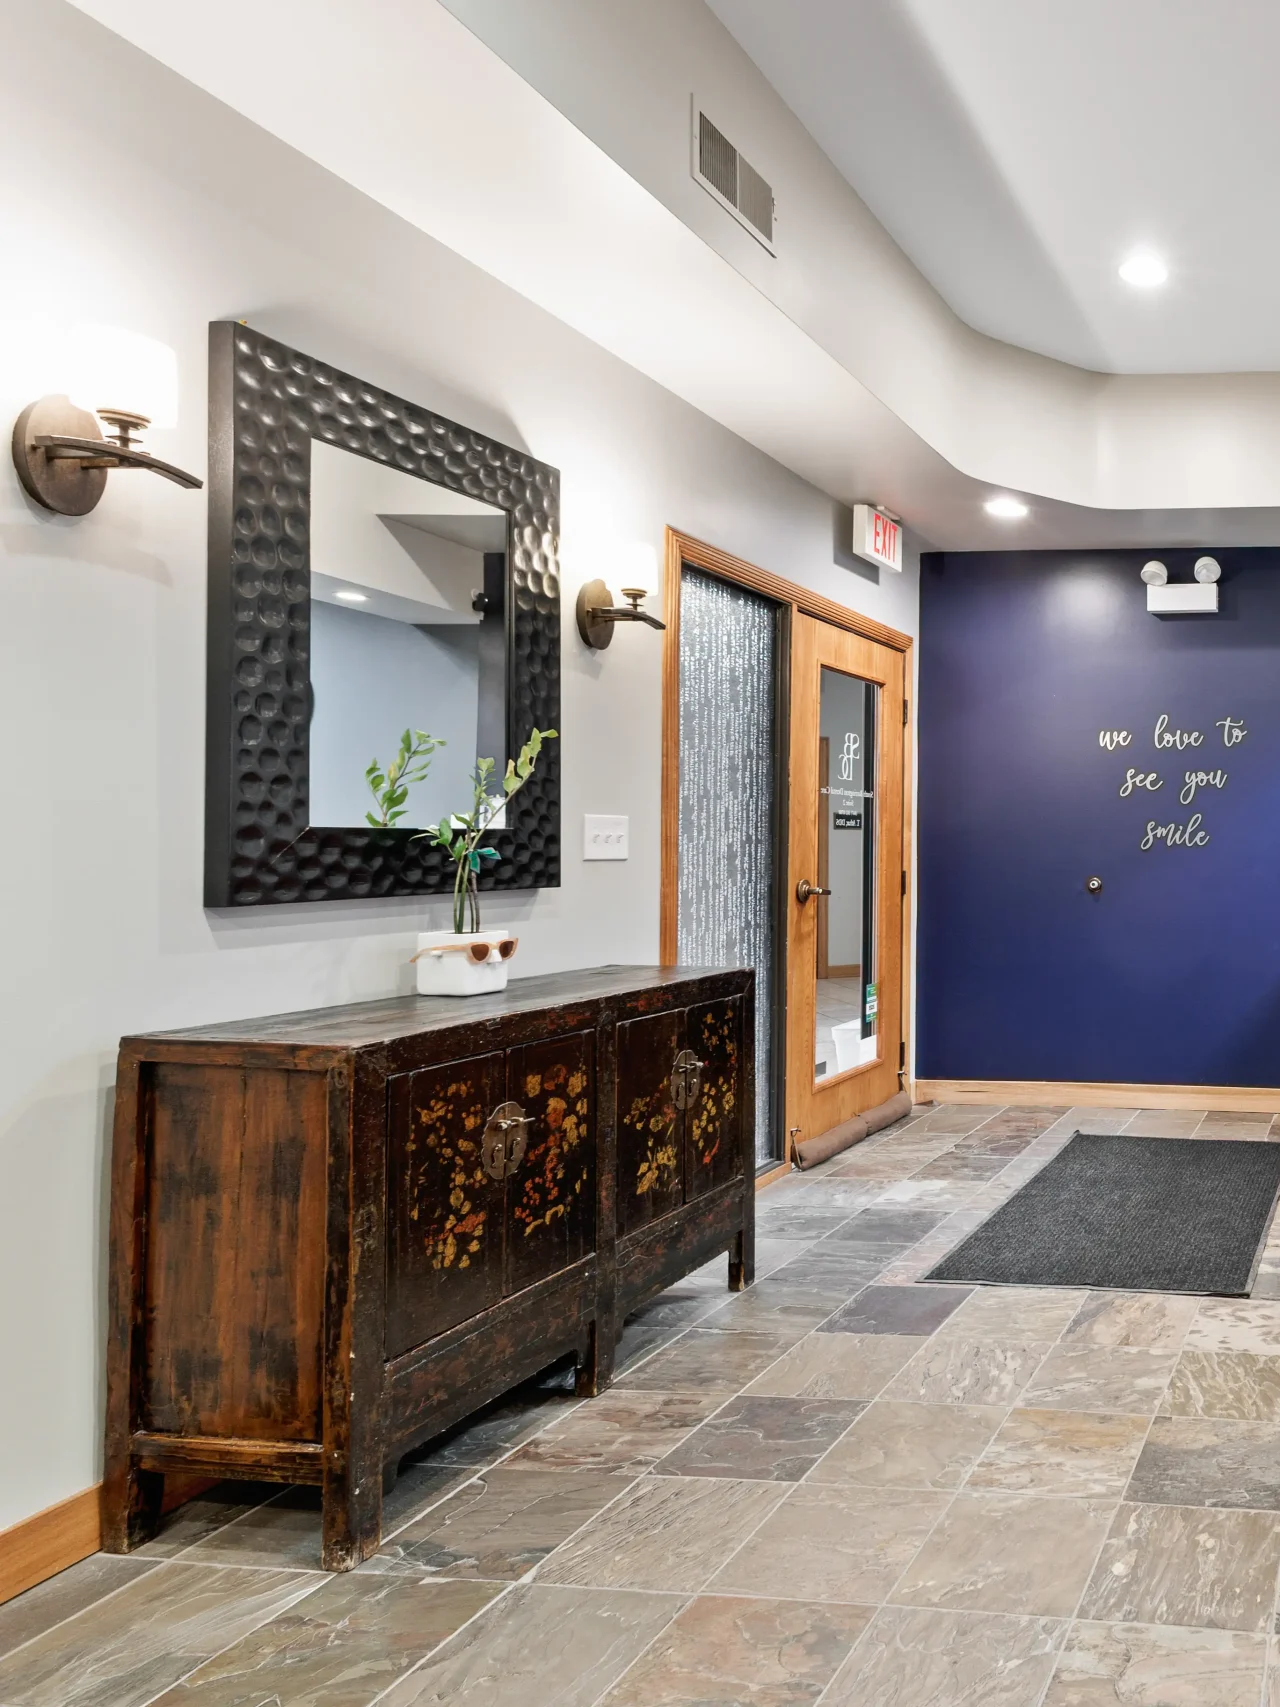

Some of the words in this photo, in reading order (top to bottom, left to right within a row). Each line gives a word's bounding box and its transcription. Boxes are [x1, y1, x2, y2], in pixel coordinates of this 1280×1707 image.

[873, 513, 898, 563] EXIT
[1099, 730, 1132, 750] we
[1154, 714, 1204, 750] love
[1216, 717, 1247, 747] to
[1119, 768, 1163, 797] see
[1179, 769, 1227, 804] you
[1140, 813, 1210, 850] smile
